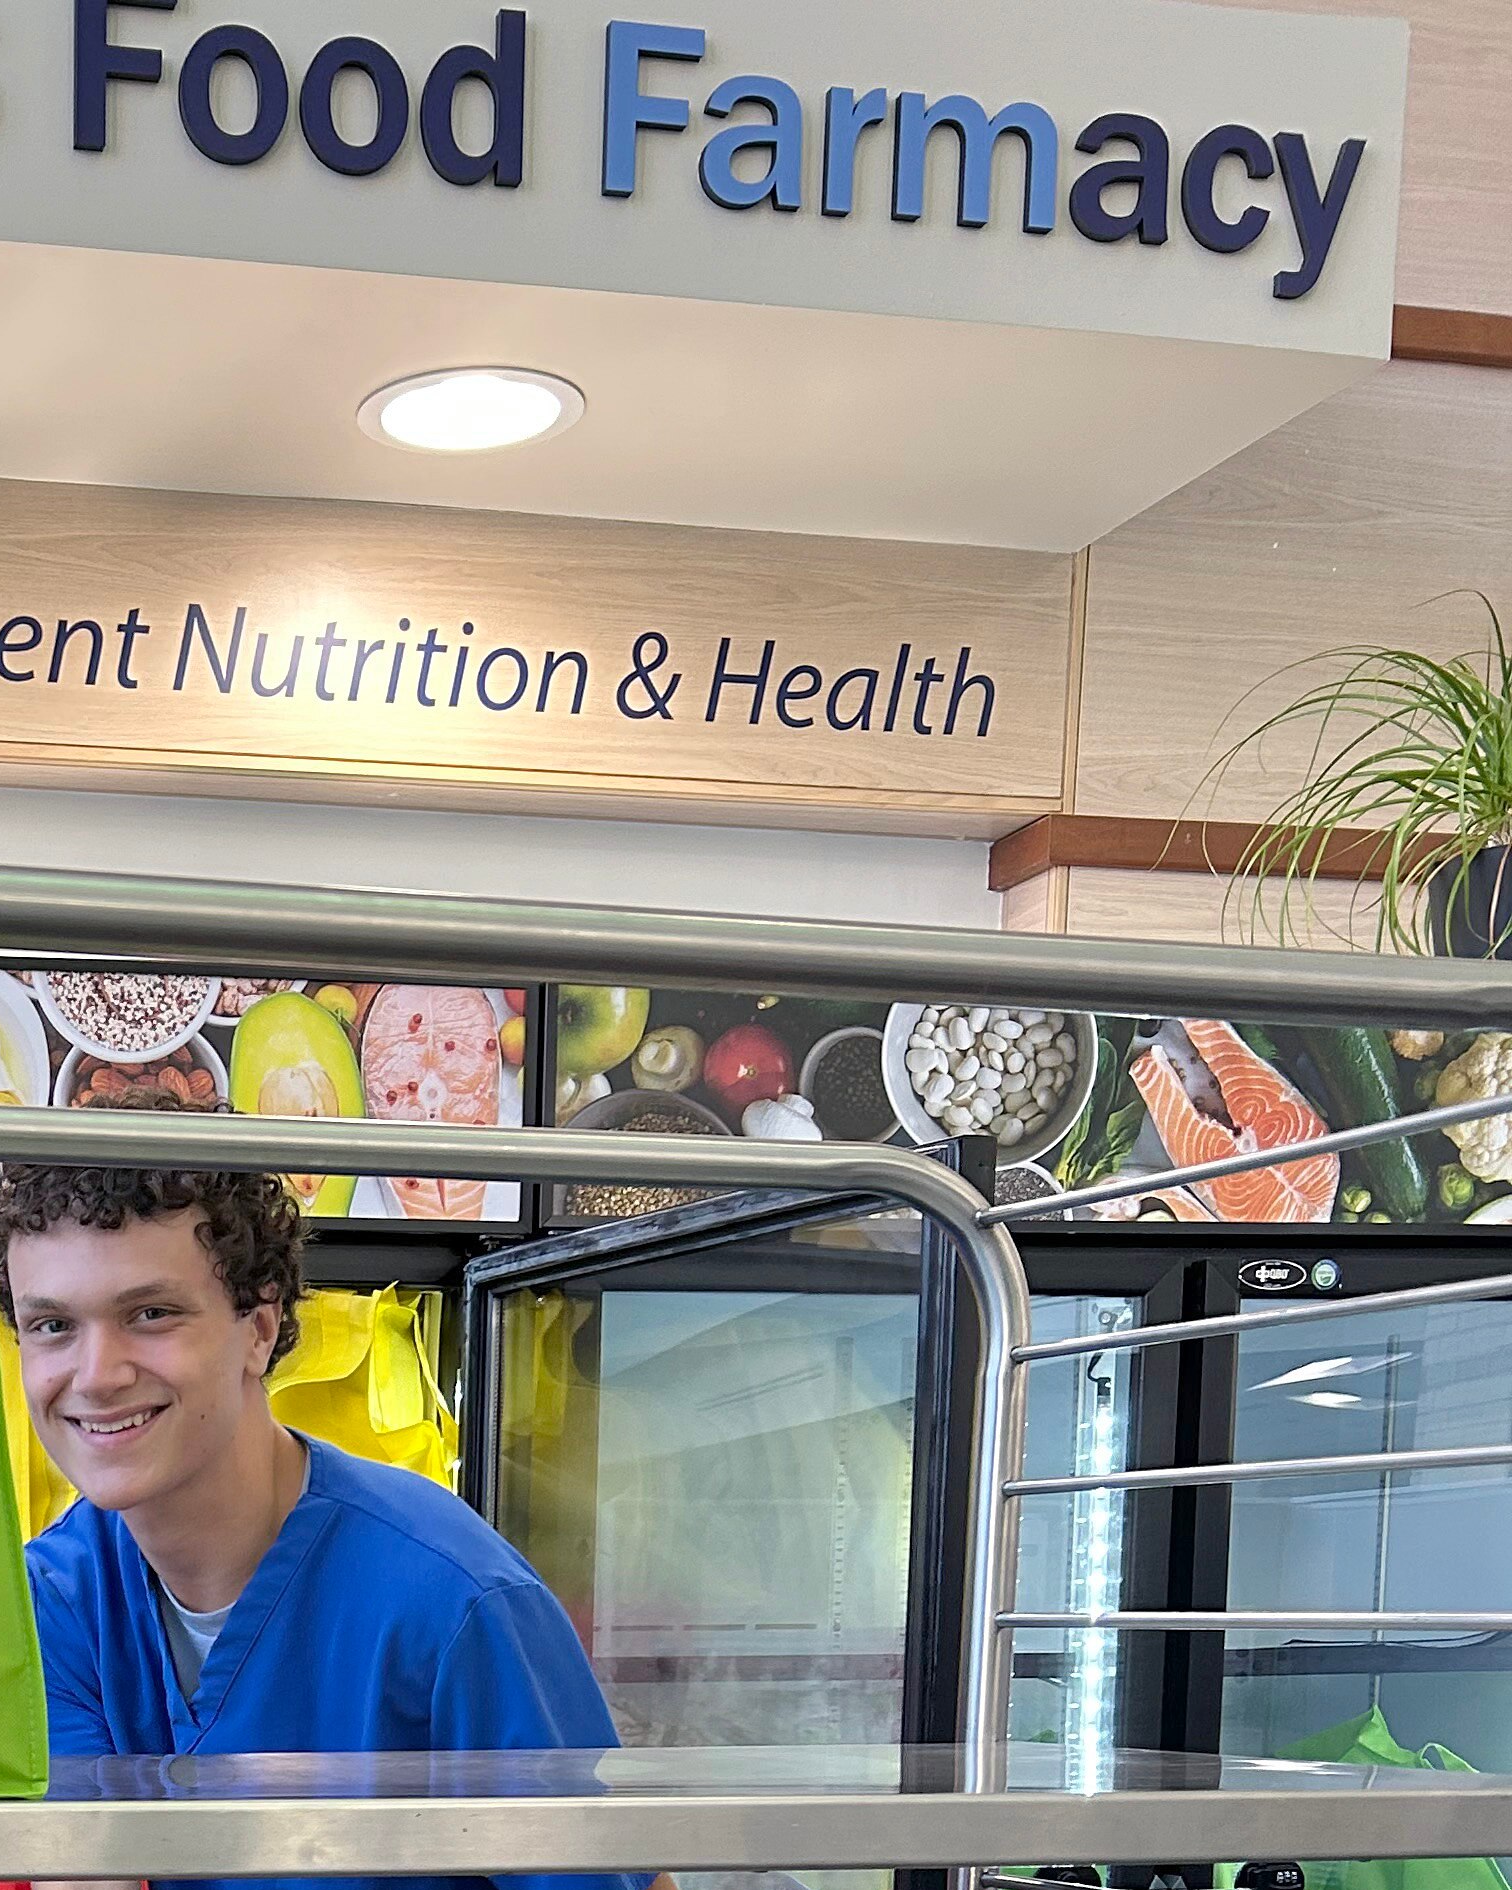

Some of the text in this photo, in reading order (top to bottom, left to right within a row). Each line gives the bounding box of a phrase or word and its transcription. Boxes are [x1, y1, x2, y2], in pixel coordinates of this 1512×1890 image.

[71, 0, 528, 188] Food
[601, 18, 1368, 300] Farmacy
[172, 603, 589, 715] Nutrition
[617, 631, 683, 721] &
[705, 637, 998, 738] Health
